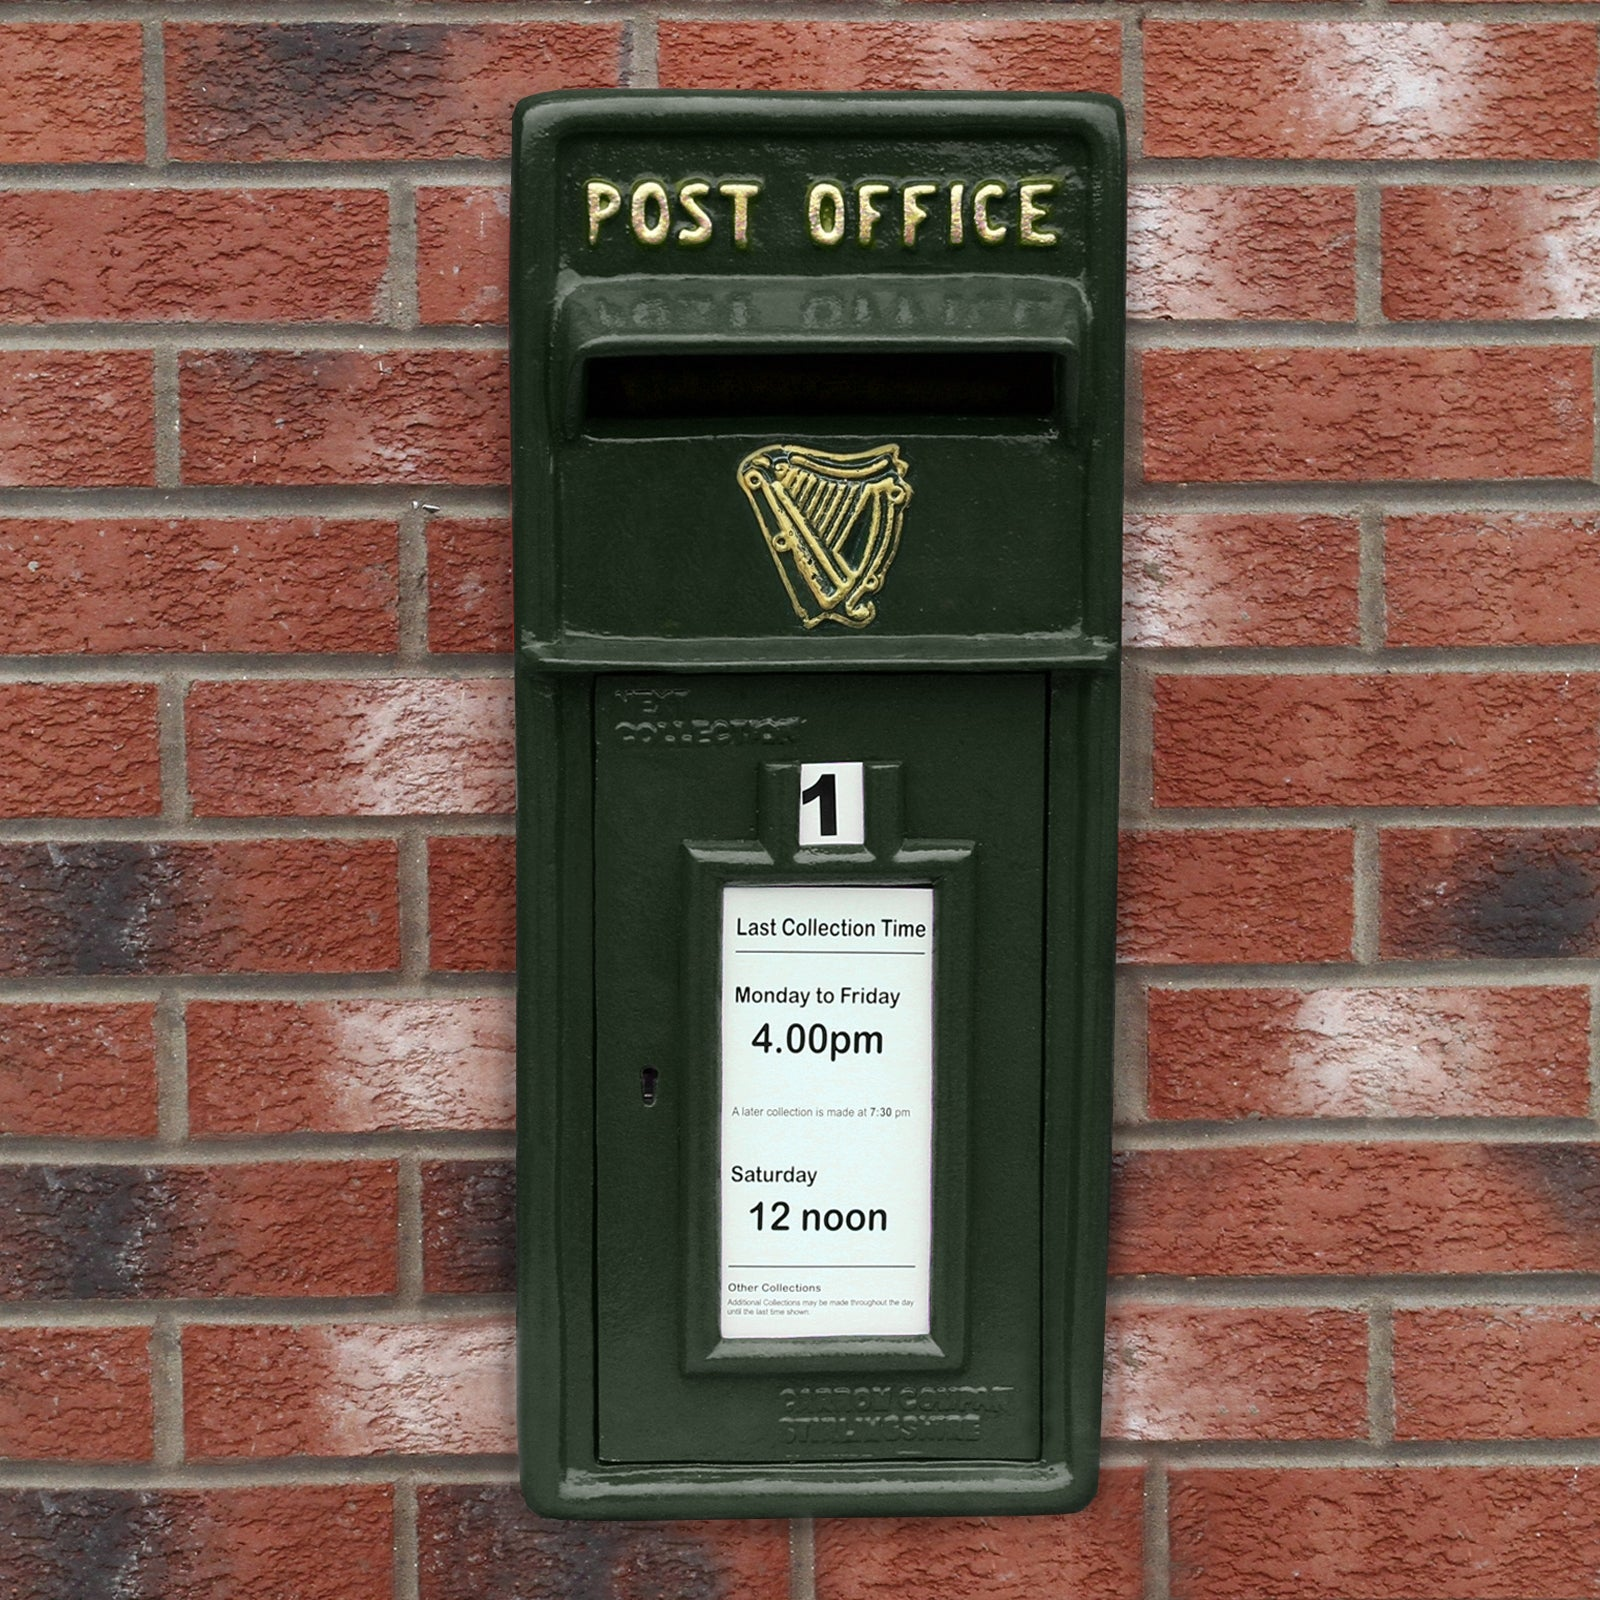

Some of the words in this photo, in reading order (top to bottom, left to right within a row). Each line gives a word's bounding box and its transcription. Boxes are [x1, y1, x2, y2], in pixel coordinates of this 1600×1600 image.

[586, 178, 759, 244] POST
[807, 178, 1057, 246] OFFICE
[801, 773, 838, 837] 1
[736, 917, 777, 937] Last
[781, 917, 876, 937] Collection
[880, 918, 927, 938] Time
[735, 986, 811, 1009] Monday
[815, 987, 835, 1004] to
[840, 986, 901, 1009] Friday
[751, 1022, 883, 1062] 4.00pm
[731, 1106, 740, 1117] A
[741, 1106, 764, 1117] later
[766, 1106, 813, 1117] collection
[815, 1106, 824, 1118] is
[826, 1107, 855, 1118] made
[857, 1108, 868, 1118] at
[869, 1106, 893, 1118] 7:30
[894, 1108, 911, 1120] pm
[731, 1165, 818, 1188] Saturday
[749, 1201, 790, 1231] 12
[802, 1208, 887, 1232] noon
[727, 1282, 759, 1293] Other
[761, 1282, 822, 1293] Collections
[726, 1298, 762, 1306] Additional
[763, 1298, 801, 1306] Collections
[802, 1300, 818, 1308] may
[818, 1299, 828, 1307] be
[829, 1299, 849, 1307] made
[850, 1298, 888, 1308] throughout
[889, 1298, 900, 1307] the
[901, 1299, 915, 1308] day
[726, 1308, 742, 1316] until
[743, 1308, 755, 1316] the
[755, 1308, 769, 1316] last
[770, 1308, 786, 1316] time
